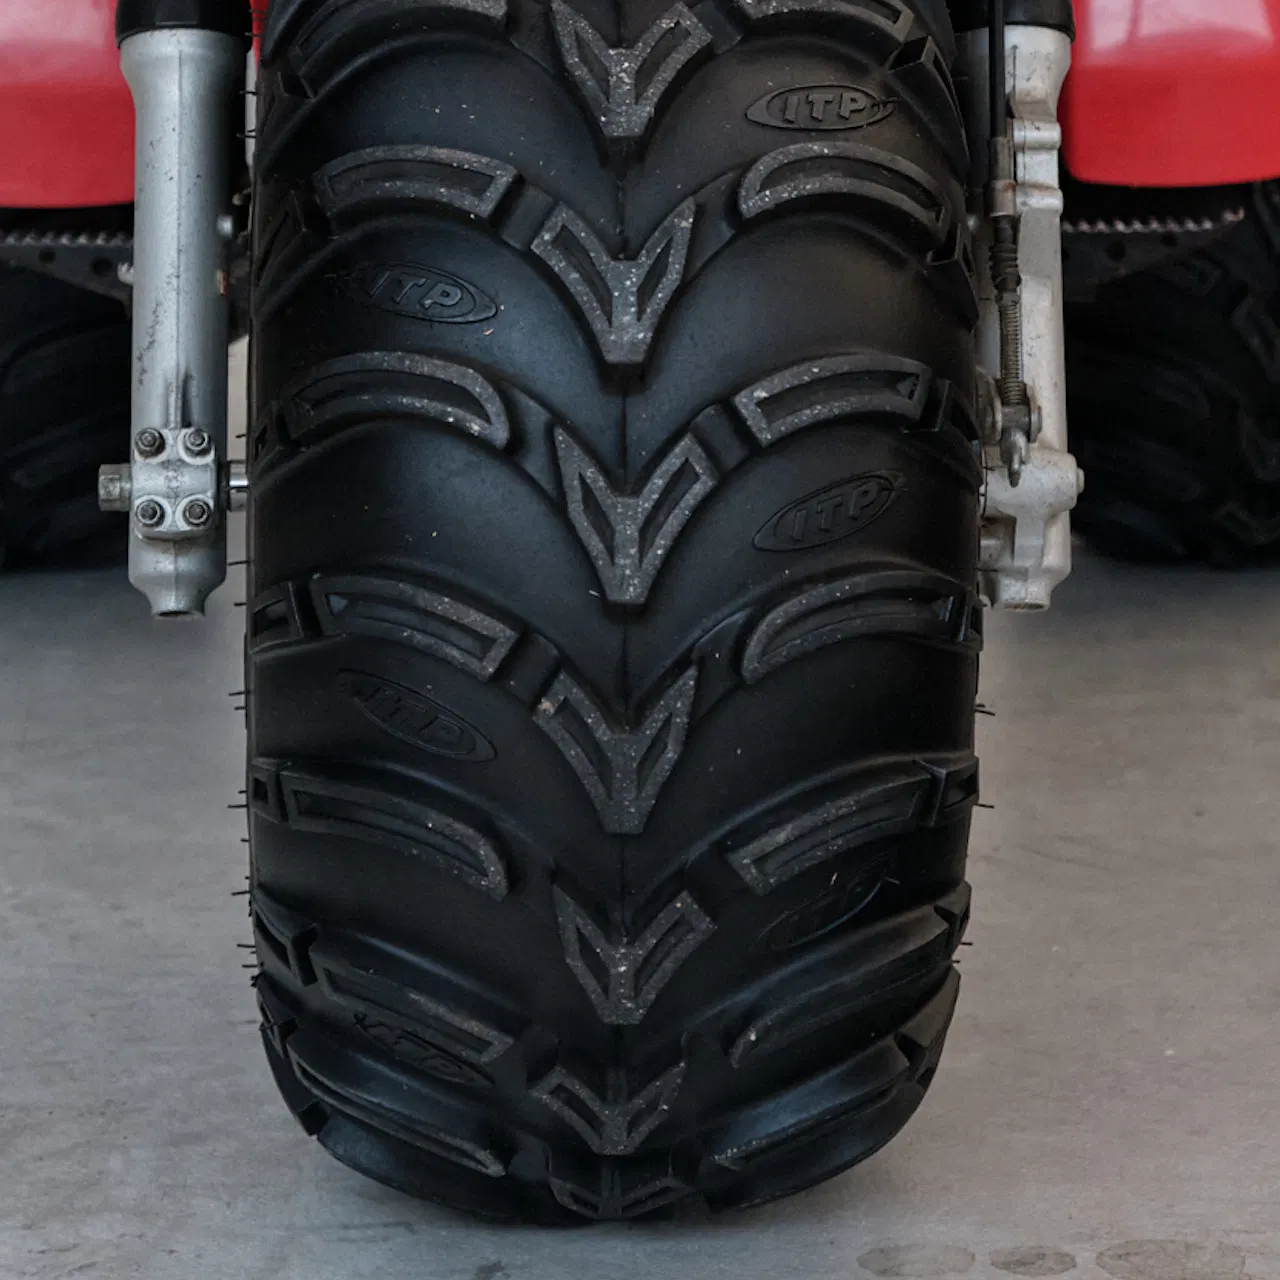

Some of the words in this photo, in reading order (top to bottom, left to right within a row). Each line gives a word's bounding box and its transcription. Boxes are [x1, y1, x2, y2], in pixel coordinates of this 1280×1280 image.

[782, 92, 868, 124] ITP
[364, 269, 465, 311] ITP
[790, 479, 880, 543] ITP
